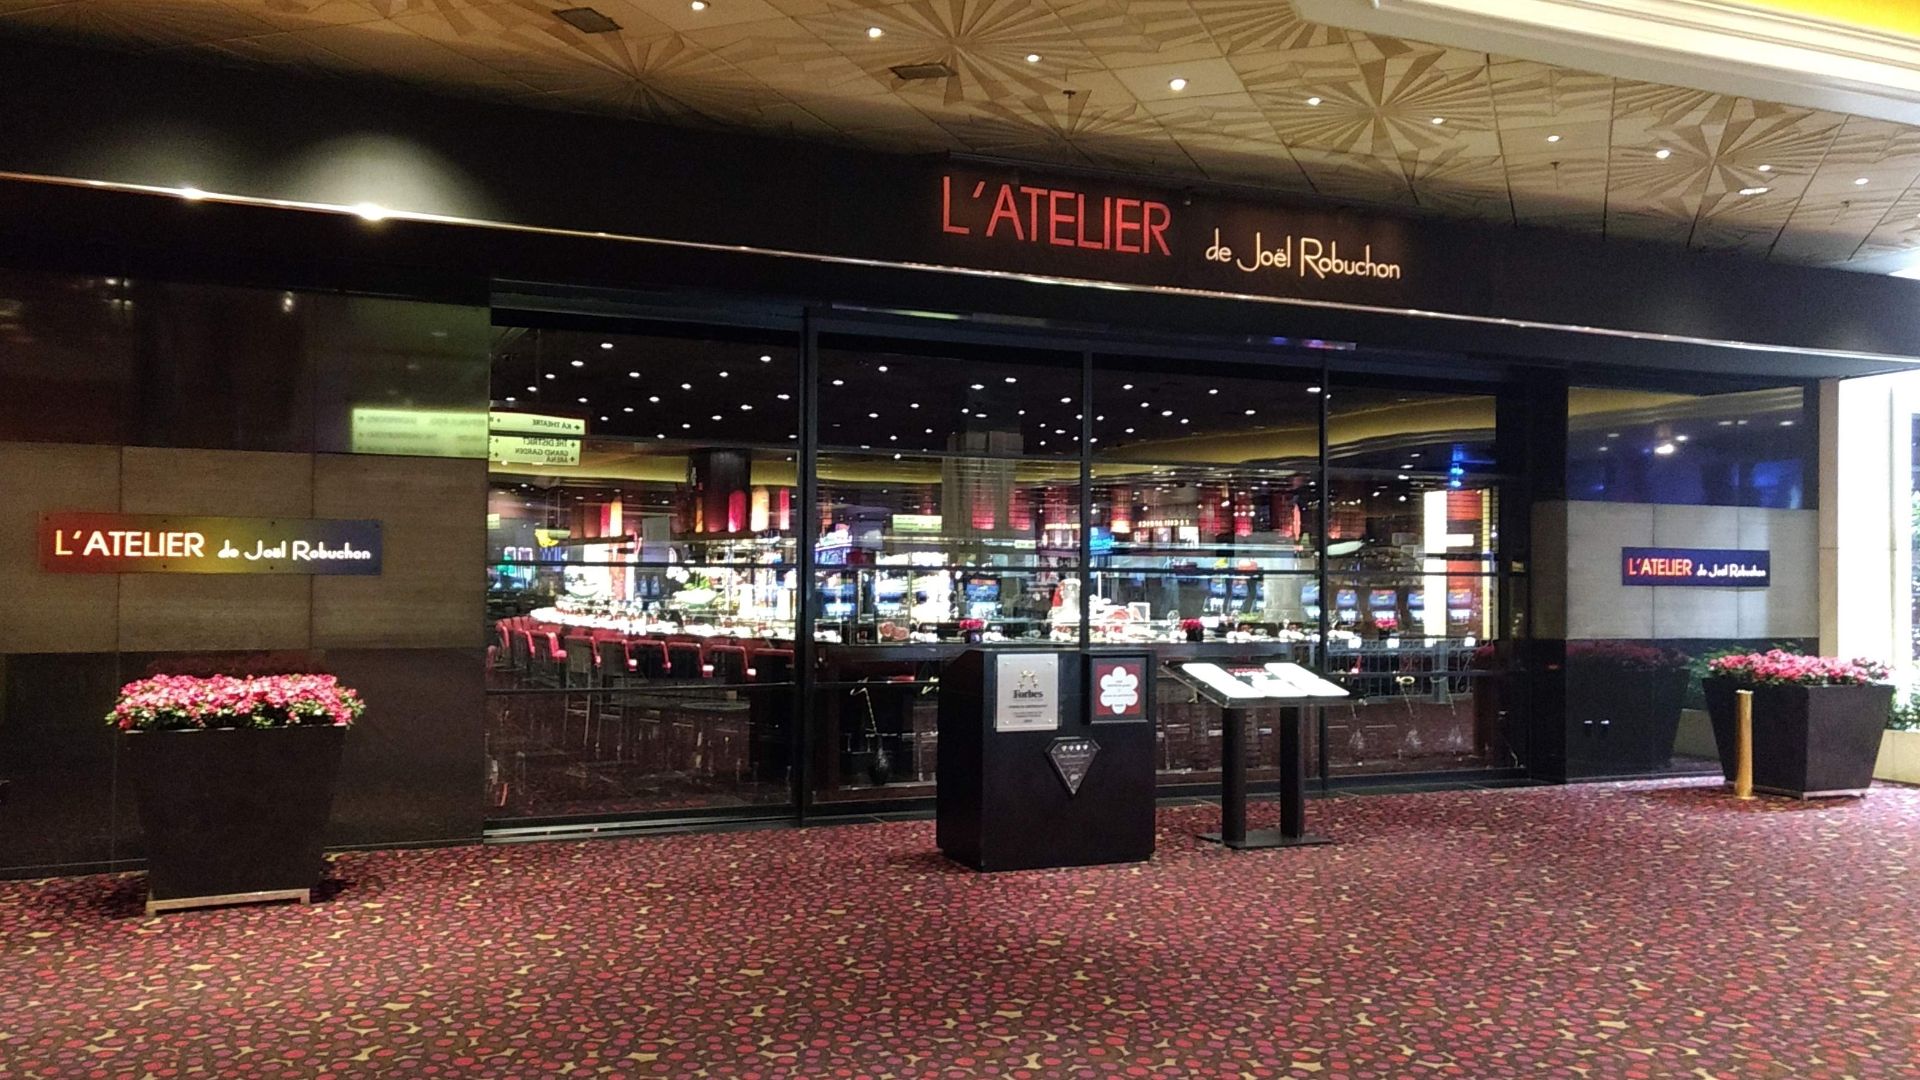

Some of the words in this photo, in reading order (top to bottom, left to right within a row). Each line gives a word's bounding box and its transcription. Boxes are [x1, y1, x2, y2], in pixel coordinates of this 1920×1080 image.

[942, 176, 1171, 256] L'ATELIER
[1205, 227, 1232, 264] de
[1236, 231, 1291, 272] Joël
[1300, 237, 1400, 280] Robuchon
[54, 529, 206, 558] L'ATELIER
[217, 540, 239, 559] de
[243, 540, 286, 561] Joël
[292, 540, 372, 562] Robuchon
[1628, 558, 1693, 576] L'ATELIER
[1013, 689, 1043, 698] Forbes
